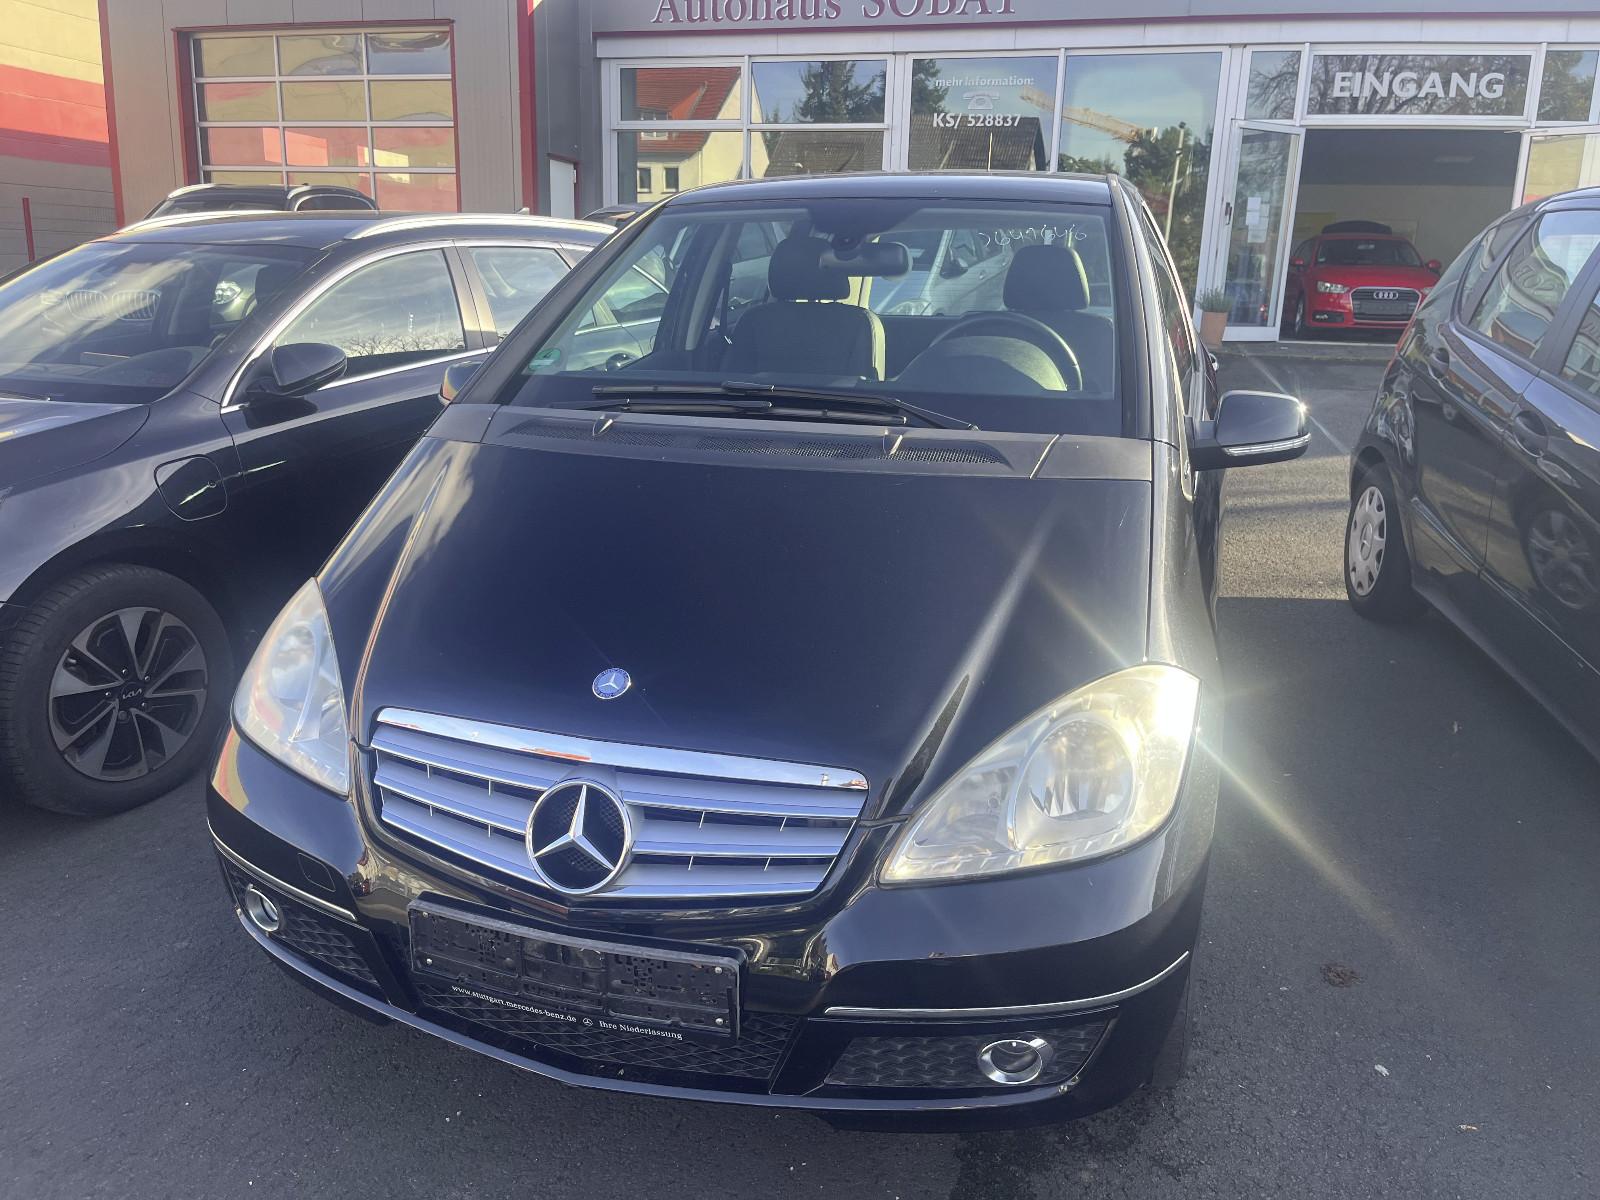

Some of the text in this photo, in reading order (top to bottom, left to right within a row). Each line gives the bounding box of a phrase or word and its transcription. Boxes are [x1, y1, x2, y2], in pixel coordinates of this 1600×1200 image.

[935, 75, 963, 87] mehr
[1333, 71, 1506, 99] EINGANG
[932, 112, 1021, 129] KS/ 528837
[451, 985, 683, 1041] www.stuttgart.mercedes-benz.de Ihre Niederlassung
